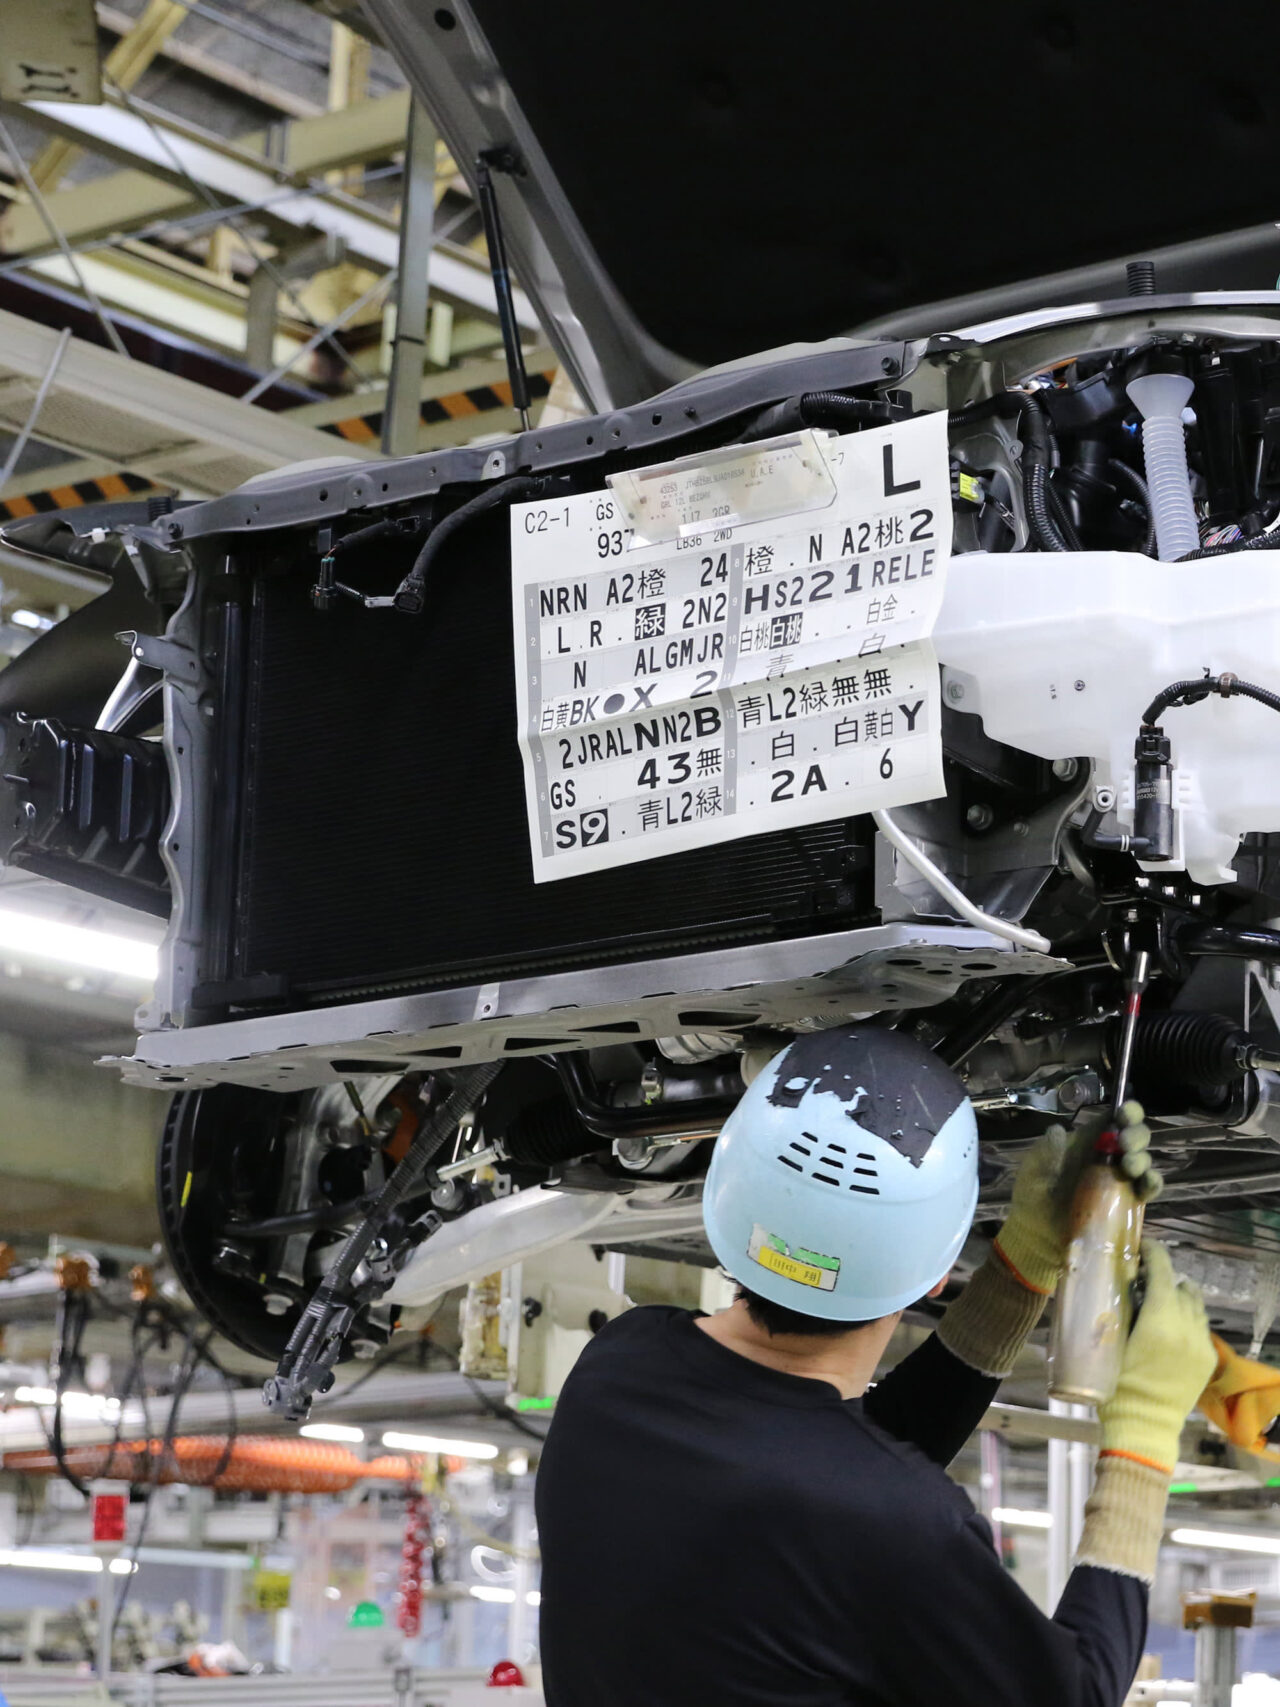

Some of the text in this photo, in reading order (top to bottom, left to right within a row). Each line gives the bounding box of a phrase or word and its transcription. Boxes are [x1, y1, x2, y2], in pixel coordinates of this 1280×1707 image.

[882, 443, 921, 498] L
[525, 502, 614, 534] C2-1 GS
[713, 527, 734, 543] 2WD
[745, 545, 775, 577] 橙
[809, 533, 823, 563] N
[540, 582, 587, 617] NRN
[700, 552, 729, 587] 24
[558, 626, 571, 654] L
[590, 620, 603, 648] R
[635, 603, 666, 641] 緑
[682, 592, 728, 629] 2N2
[866, 593, 898, 625] 白金
[858, 632, 887, 658] 白
[574, 660, 587, 689] N
[690, 670, 719, 699] 2
[771, 730, 795, 761] 白
[771, 764, 828, 803] 2A
[879, 748, 893, 780] 6
[550, 779, 577, 810] GS
